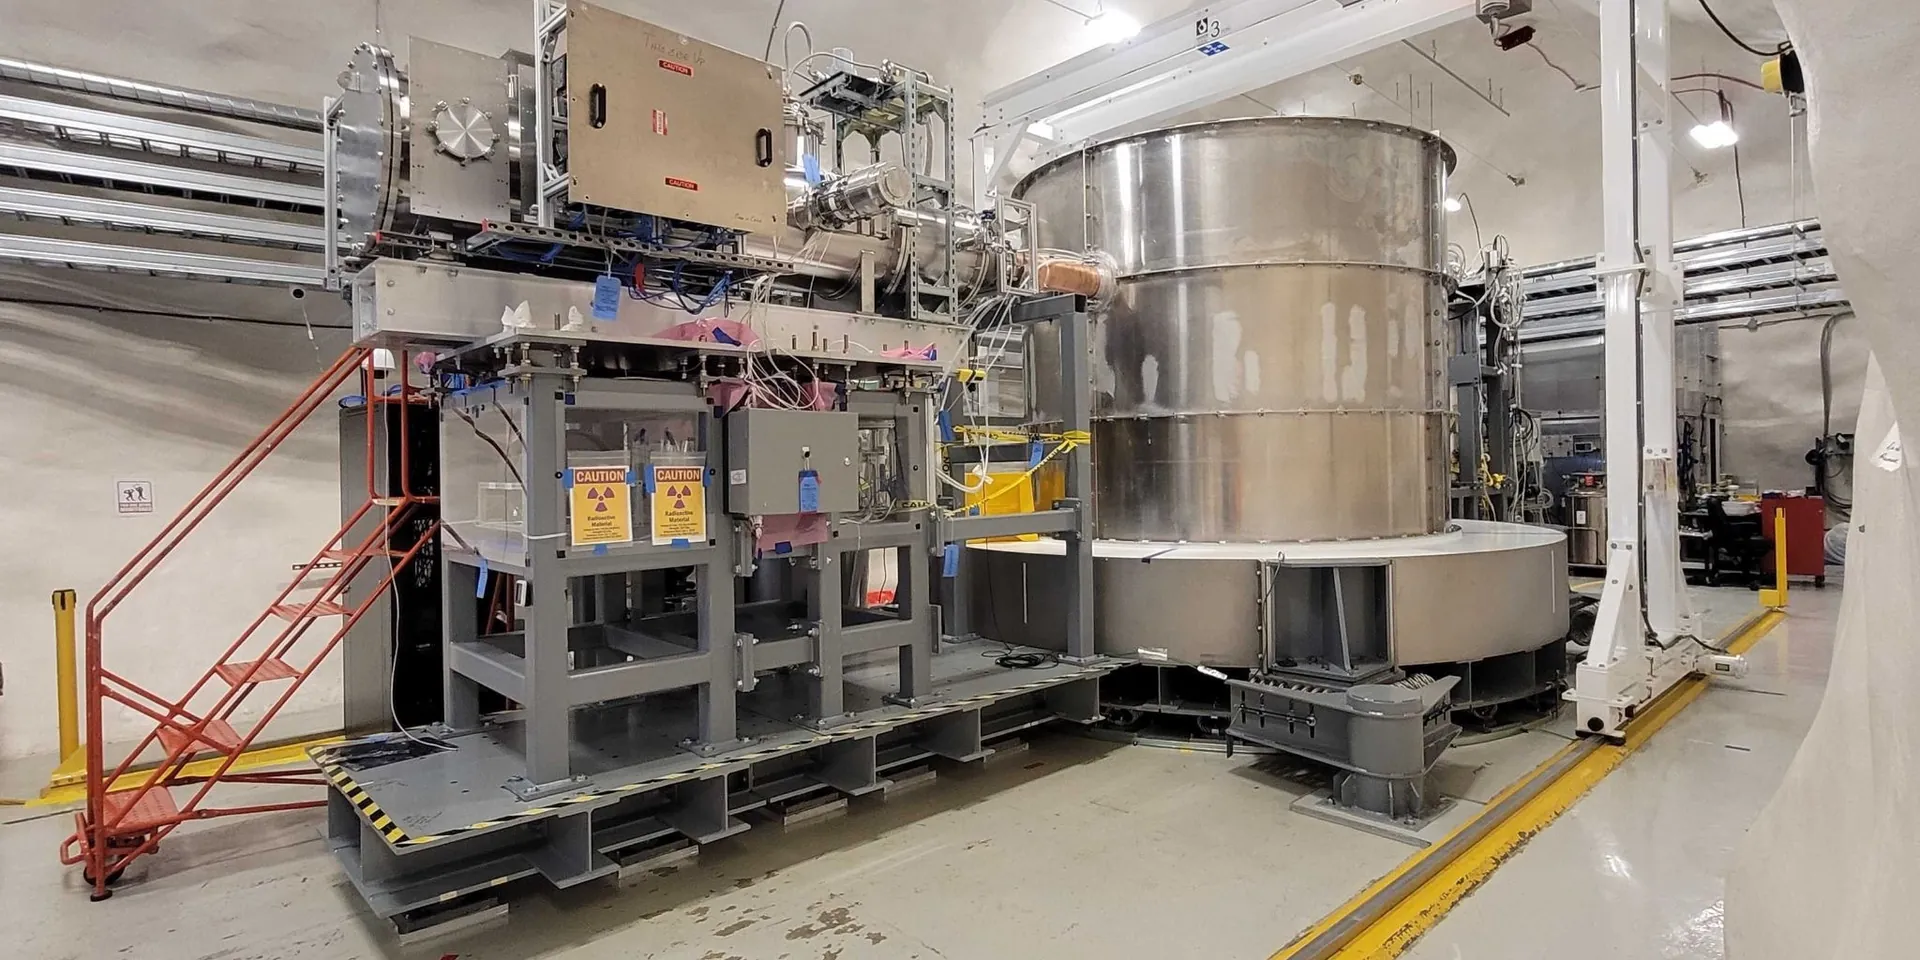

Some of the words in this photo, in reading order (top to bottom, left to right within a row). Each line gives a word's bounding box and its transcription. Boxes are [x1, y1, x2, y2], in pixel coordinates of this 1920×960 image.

[1210, 20, 1220, 38] 3
[661, 61, 689, 75] CAUTION
[669, 179, 694, 189] CAUTION
[576, 470, 625, 482] CAUTION
[657, 470, 700, 480] CAUTION
